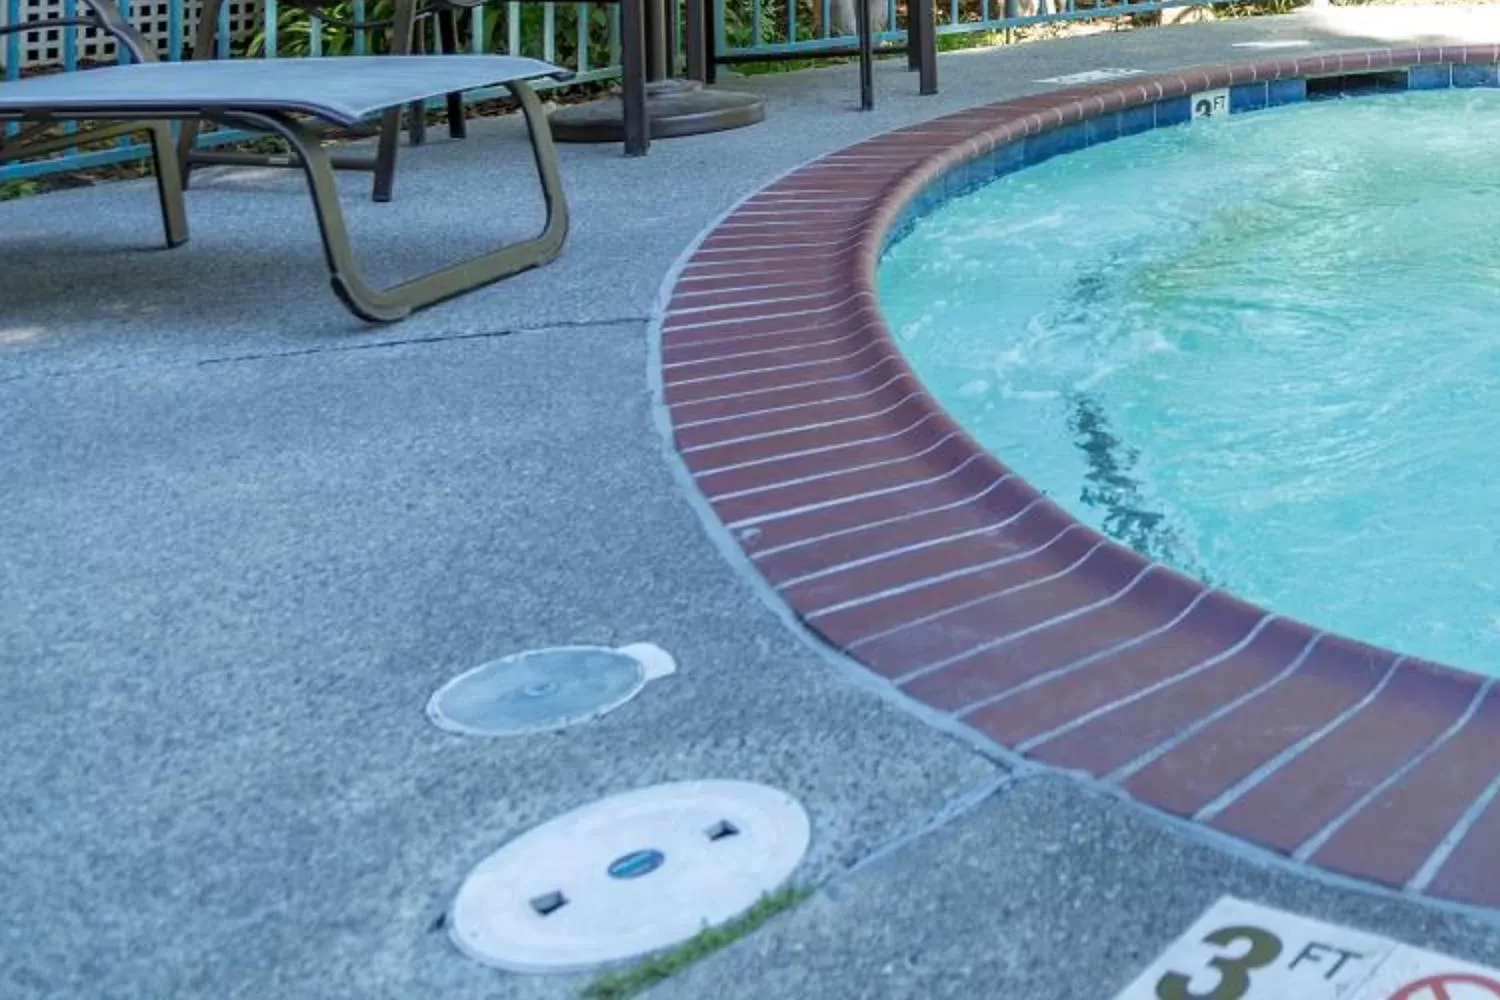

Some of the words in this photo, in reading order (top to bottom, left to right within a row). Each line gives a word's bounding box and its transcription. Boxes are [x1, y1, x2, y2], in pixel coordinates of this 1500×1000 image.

[1213, 95, 1226, 110] FT
[1155, 925, 1283, 1000] 3
[1287, 941, 1364, 981] FT
